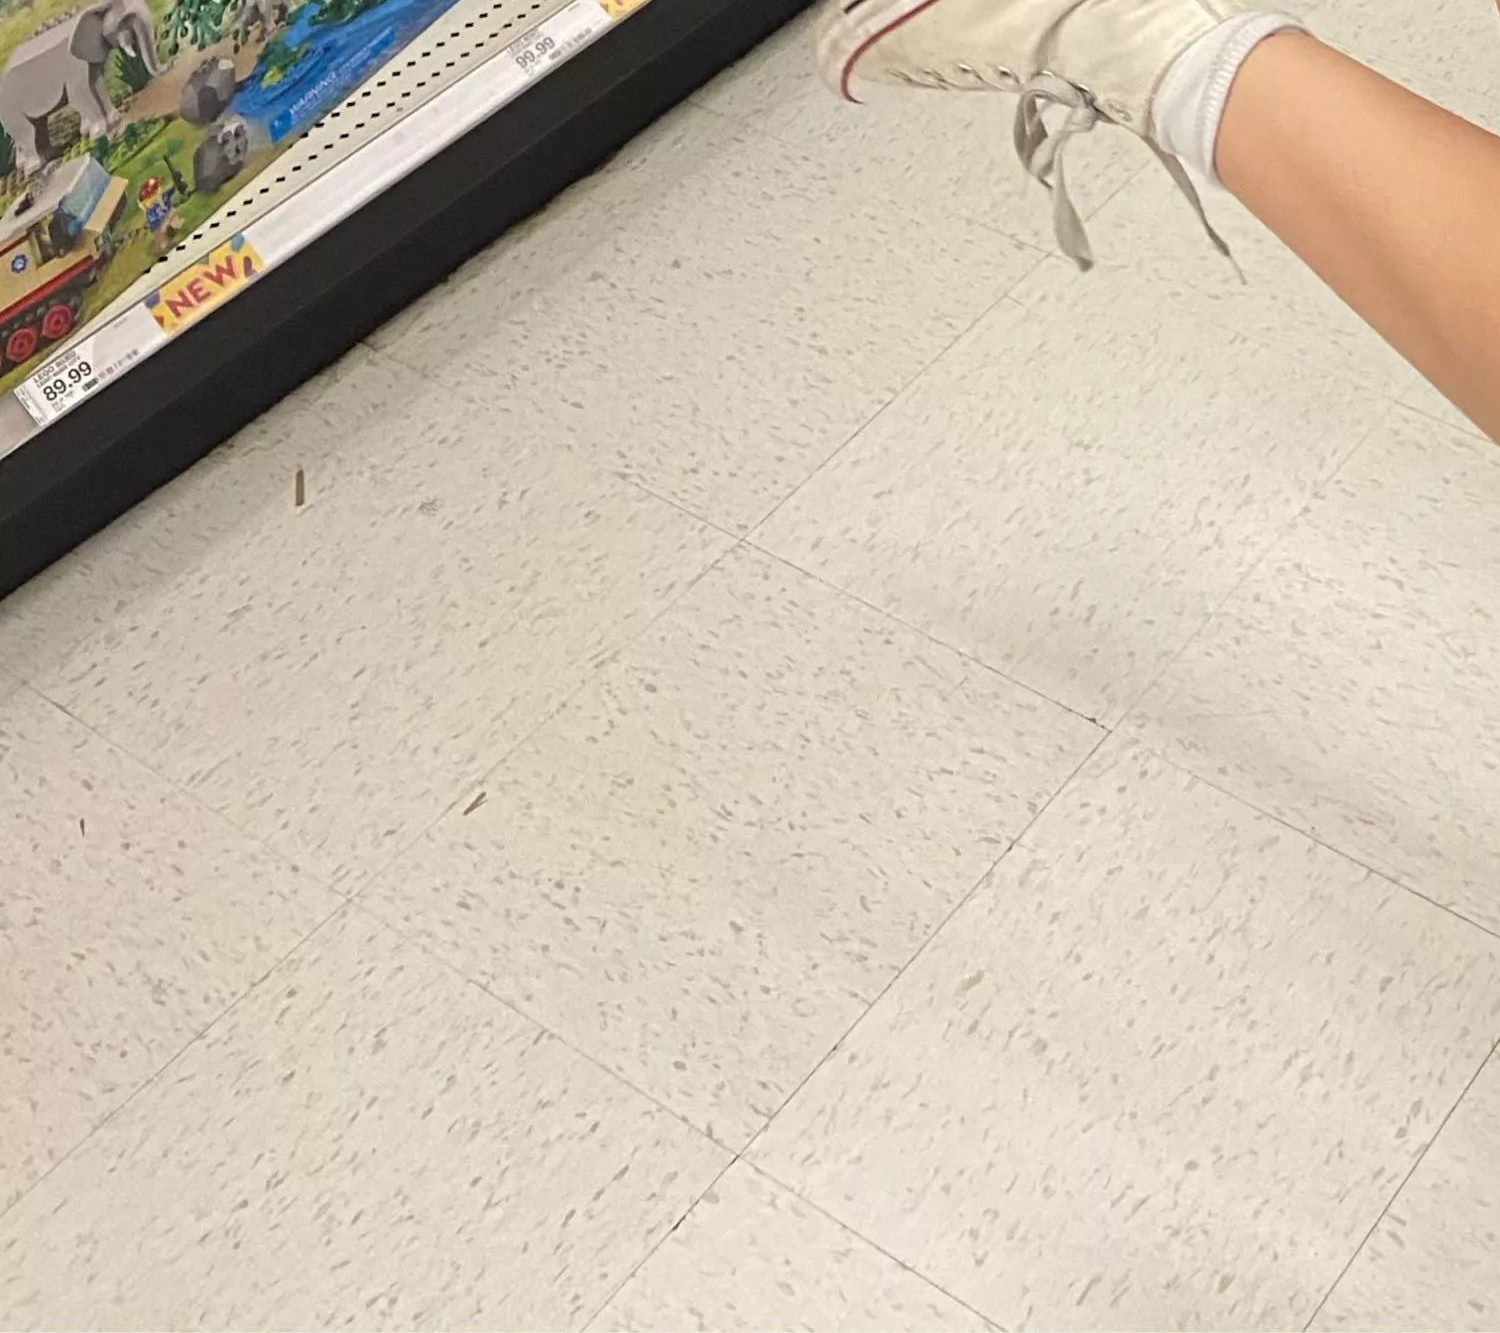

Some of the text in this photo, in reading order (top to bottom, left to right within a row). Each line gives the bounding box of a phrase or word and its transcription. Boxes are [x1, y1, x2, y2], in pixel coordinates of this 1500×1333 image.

[515, 36, 556, 69] 99.99
[167, 254, 238, 318] NEW
[43, 361, 92, 401] 89.99
